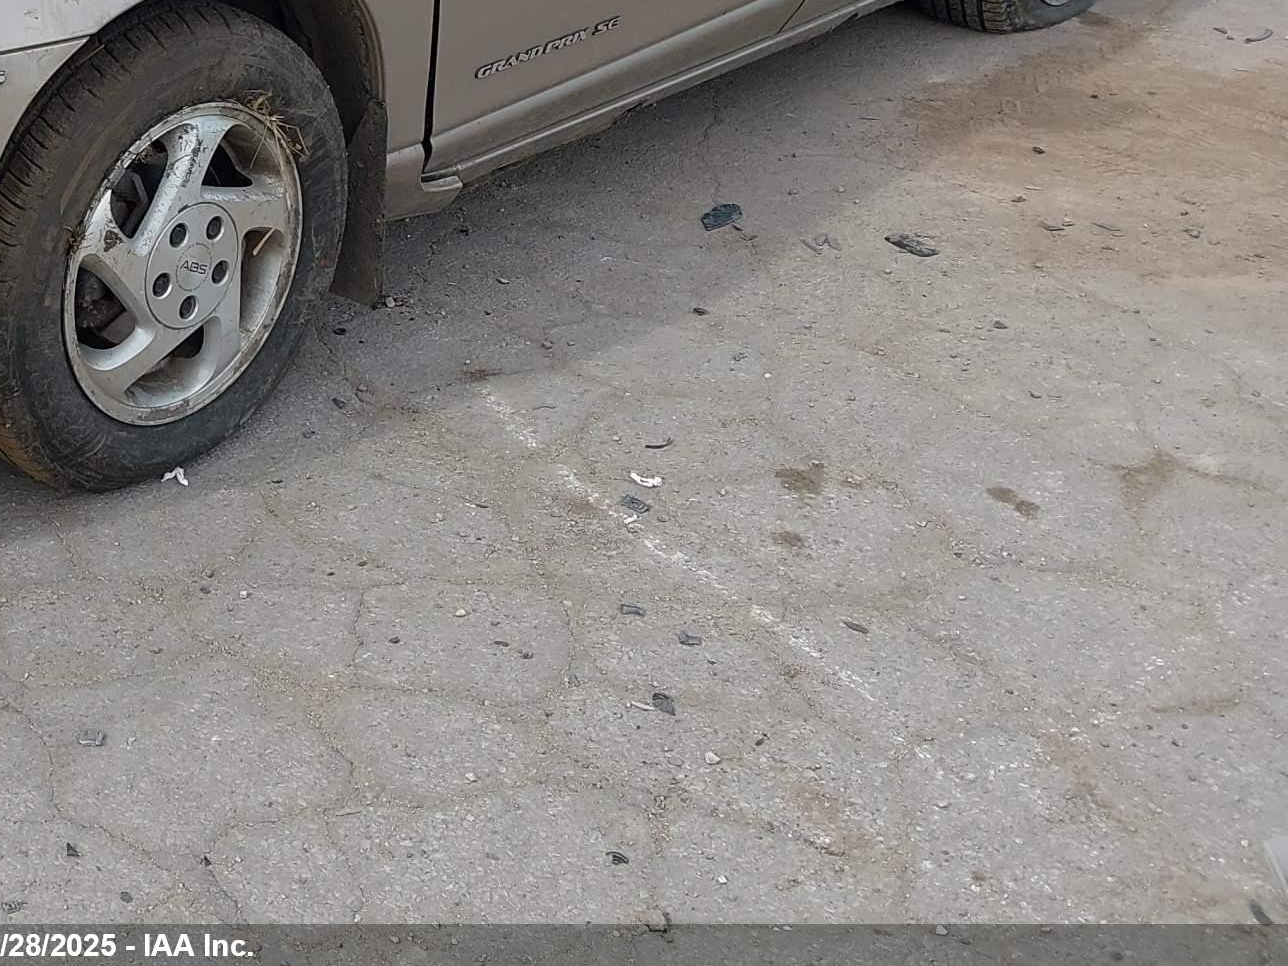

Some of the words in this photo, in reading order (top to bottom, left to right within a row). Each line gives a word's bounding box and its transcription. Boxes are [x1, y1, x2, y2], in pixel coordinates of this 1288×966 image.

[474, 45, 543, 79] GRAND
[542, 27, 590, 54] PRIX
[592, 15, 621, 36] SE
[179, 260, 208, 275] ABS
